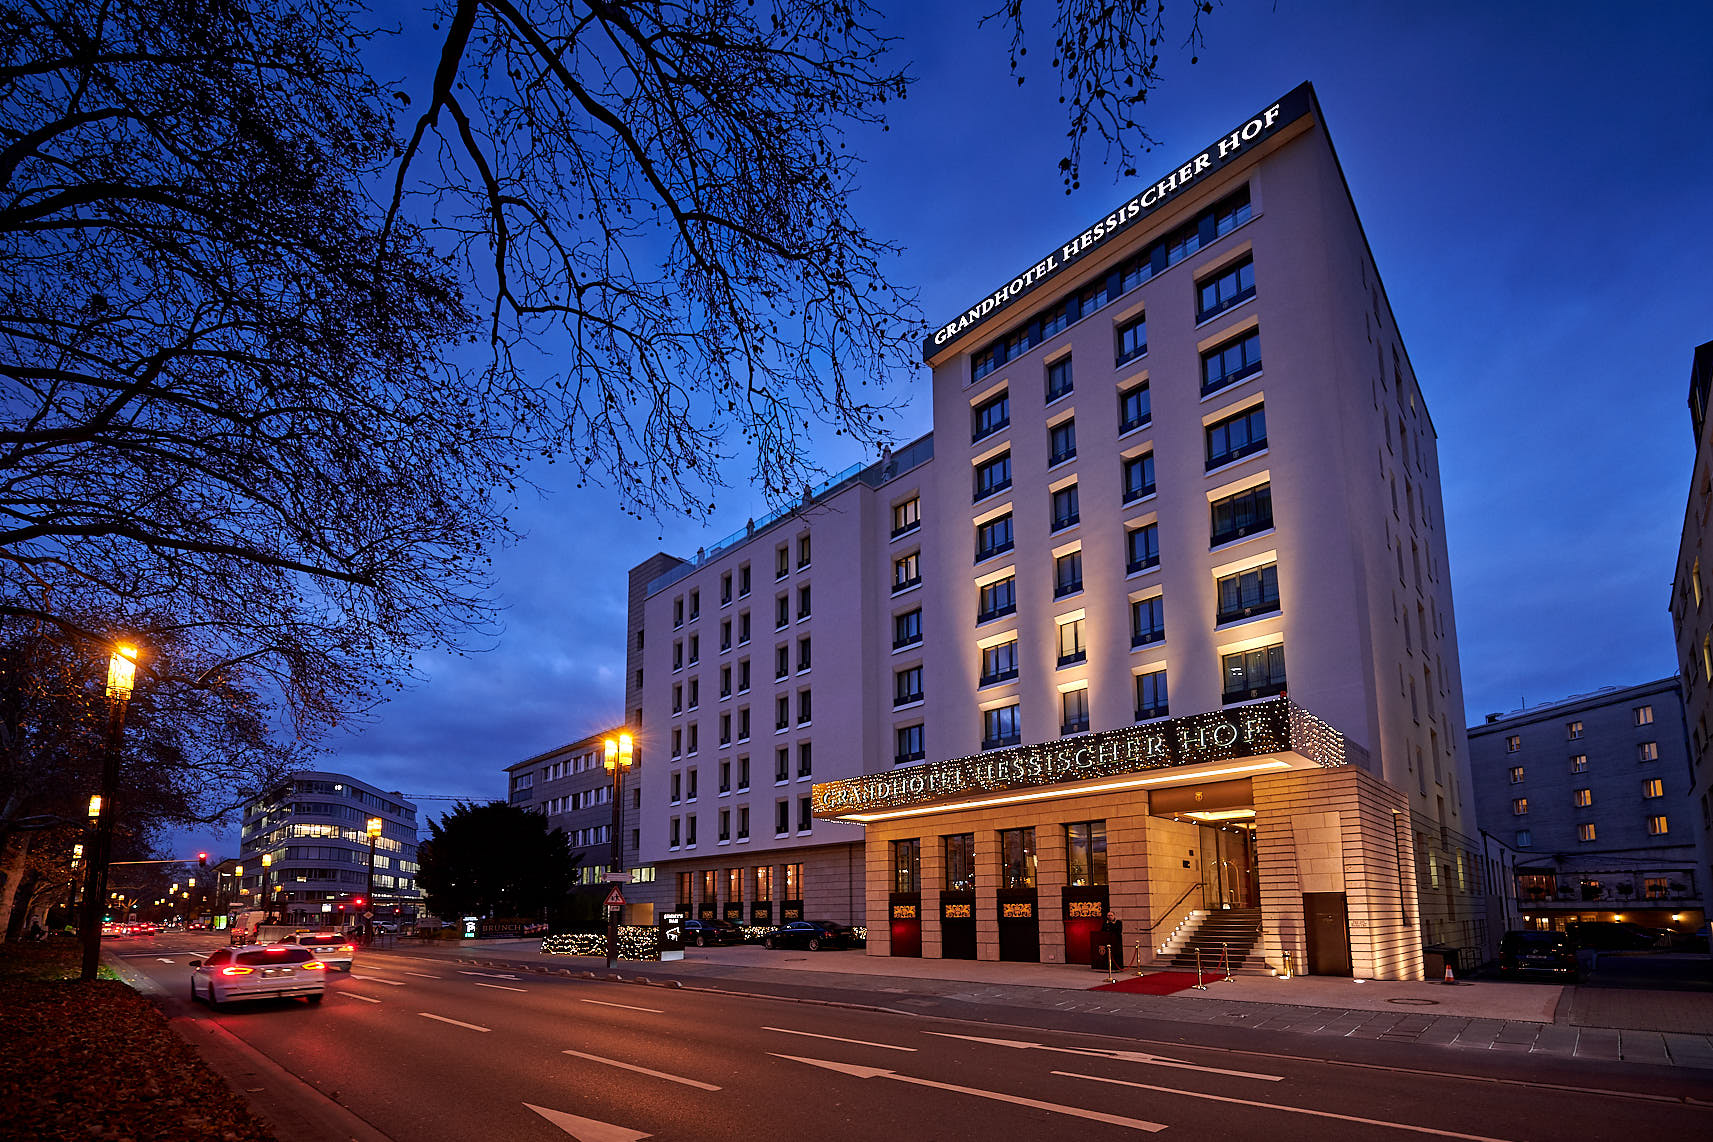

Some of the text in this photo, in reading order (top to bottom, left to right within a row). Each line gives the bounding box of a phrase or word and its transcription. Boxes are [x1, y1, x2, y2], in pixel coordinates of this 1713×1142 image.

[934, 103, 1280, 345] GRANDHOTEL HESSISCHER HOF
[822, 719, 1261, 807] GRANDHOTEL HESSISCHER HOF
[482, 924, 521, 932] BRUNCH
